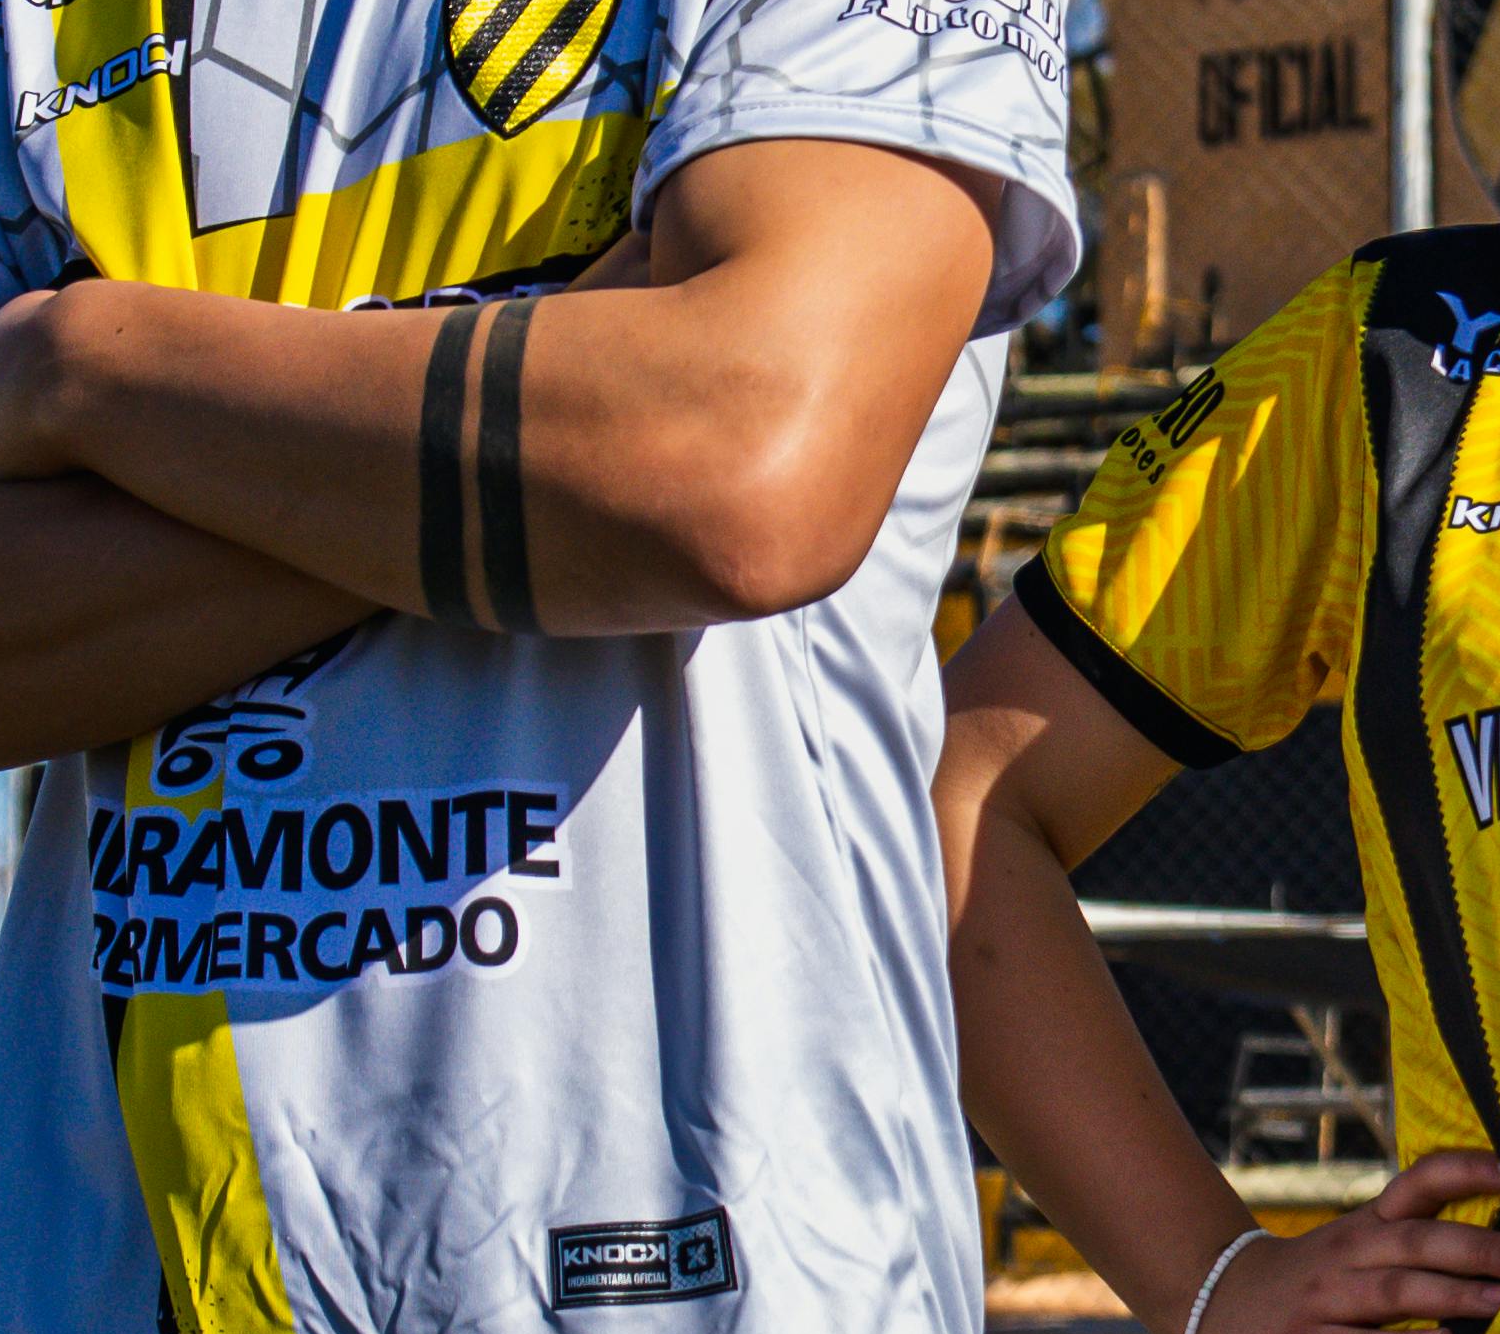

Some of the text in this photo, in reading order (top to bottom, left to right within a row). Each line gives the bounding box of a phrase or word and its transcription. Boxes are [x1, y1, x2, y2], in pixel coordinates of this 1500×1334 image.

[1197, 33, 1370, 147] OFICIAL
[1430, 342, 1473, 383] LA
[564, 1243, 667, 1266] KNOCK
